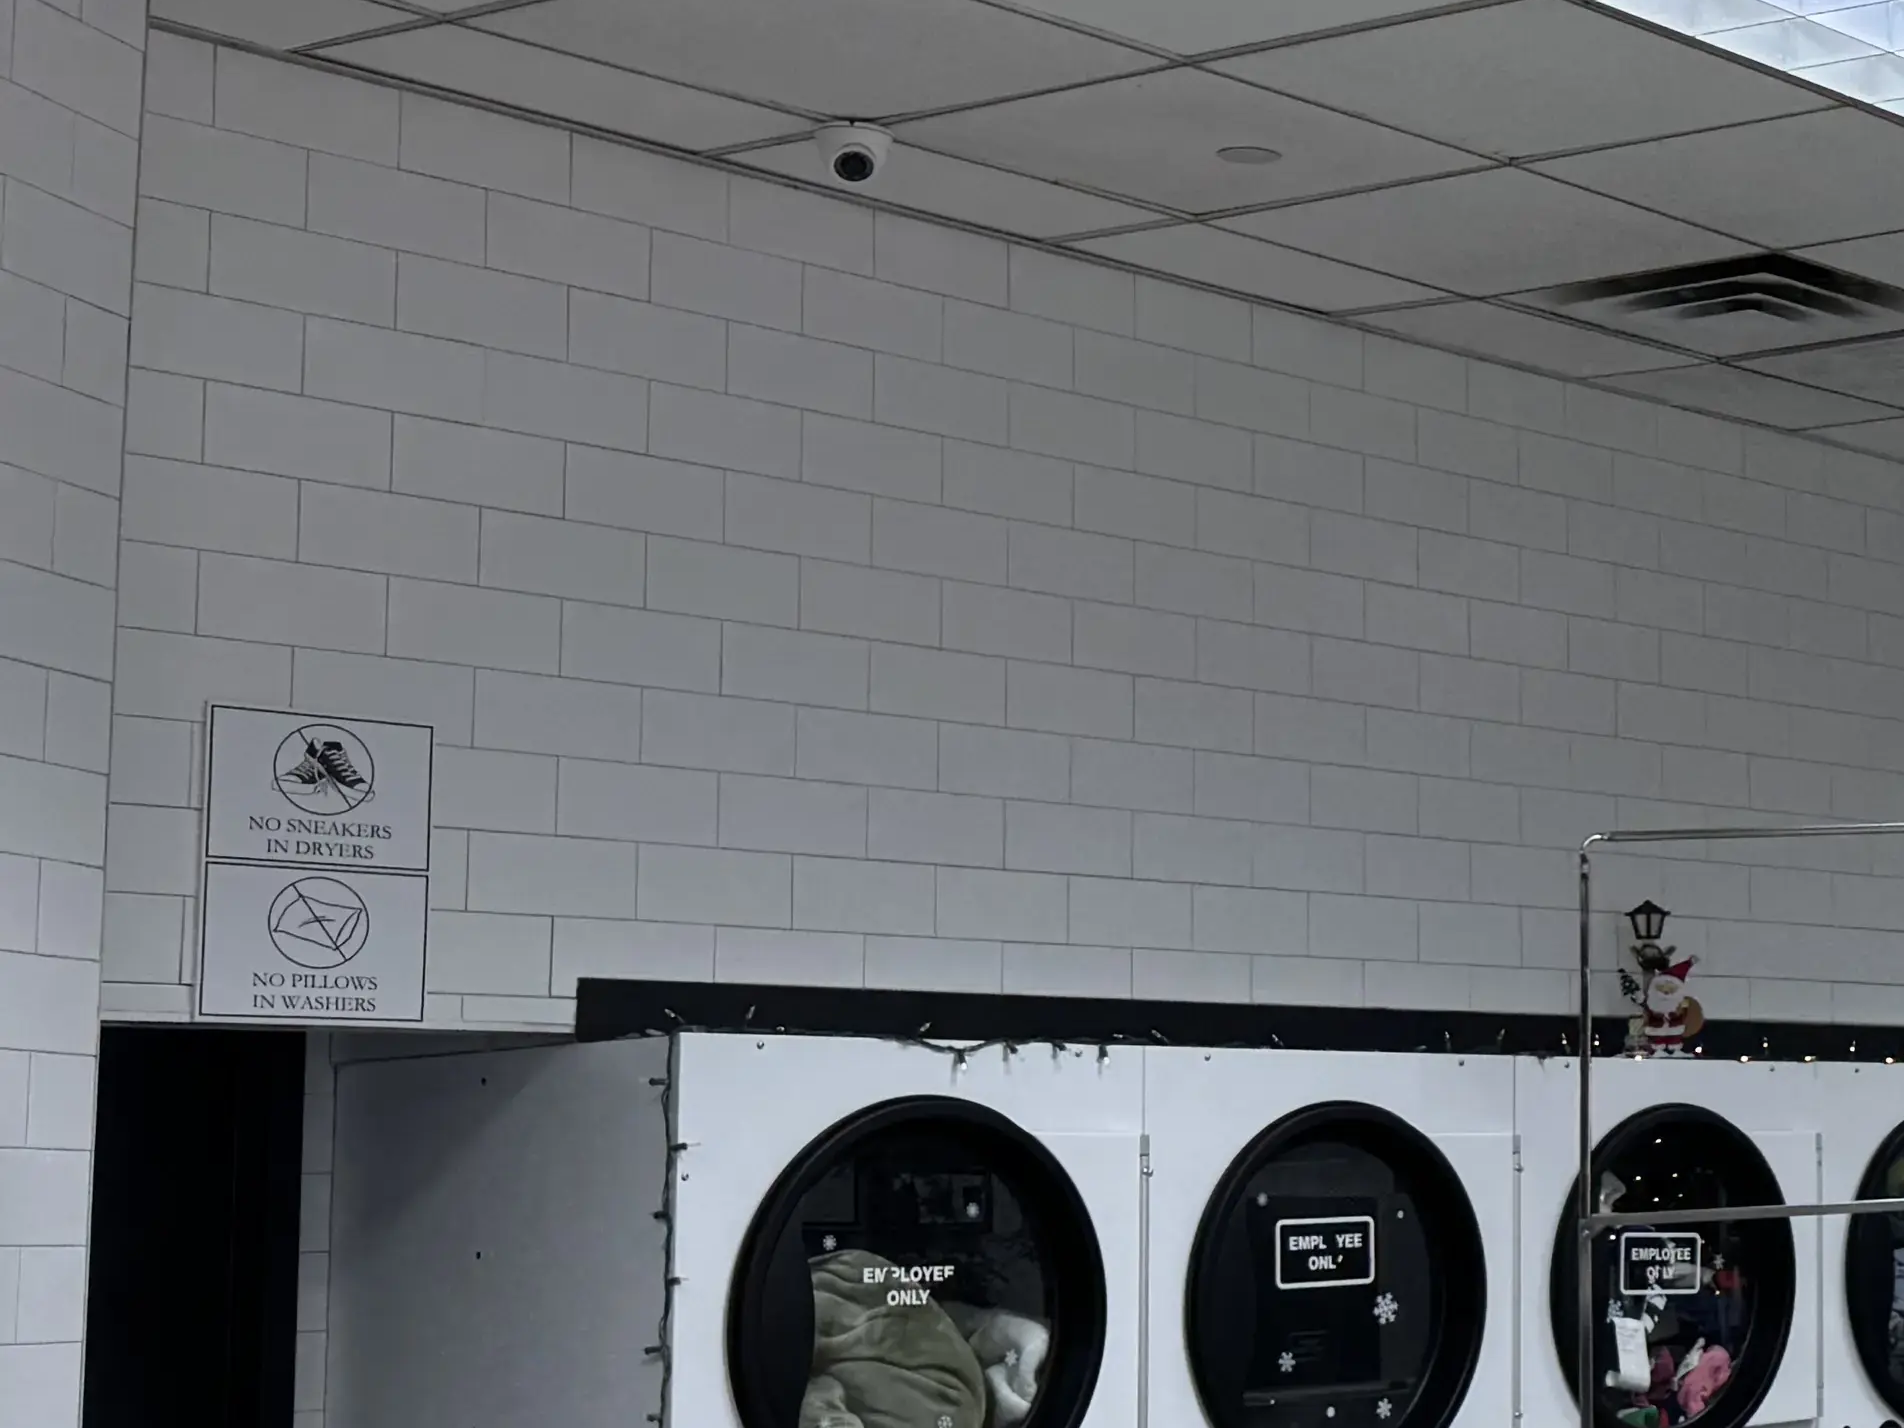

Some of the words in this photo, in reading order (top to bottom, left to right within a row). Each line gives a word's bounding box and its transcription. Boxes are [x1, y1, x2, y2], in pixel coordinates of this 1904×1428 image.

[249, 815, 281, 831] NO
[286, 818, 392, 839] SNEAKERS
[266, 838, 288, 853] IN
[295, 840, 374, 859] DRYERS
[252, 972, 285, 987] NO
[291, 973, 378, 990] PILLOWS
[253, 994, 275, 1009] IN
[281, 995, 376, 1012] WASHERS
[1289, 1233, 1363, 1251] EMPLYEE
[887, 1289, 930, 1306] ONLY
